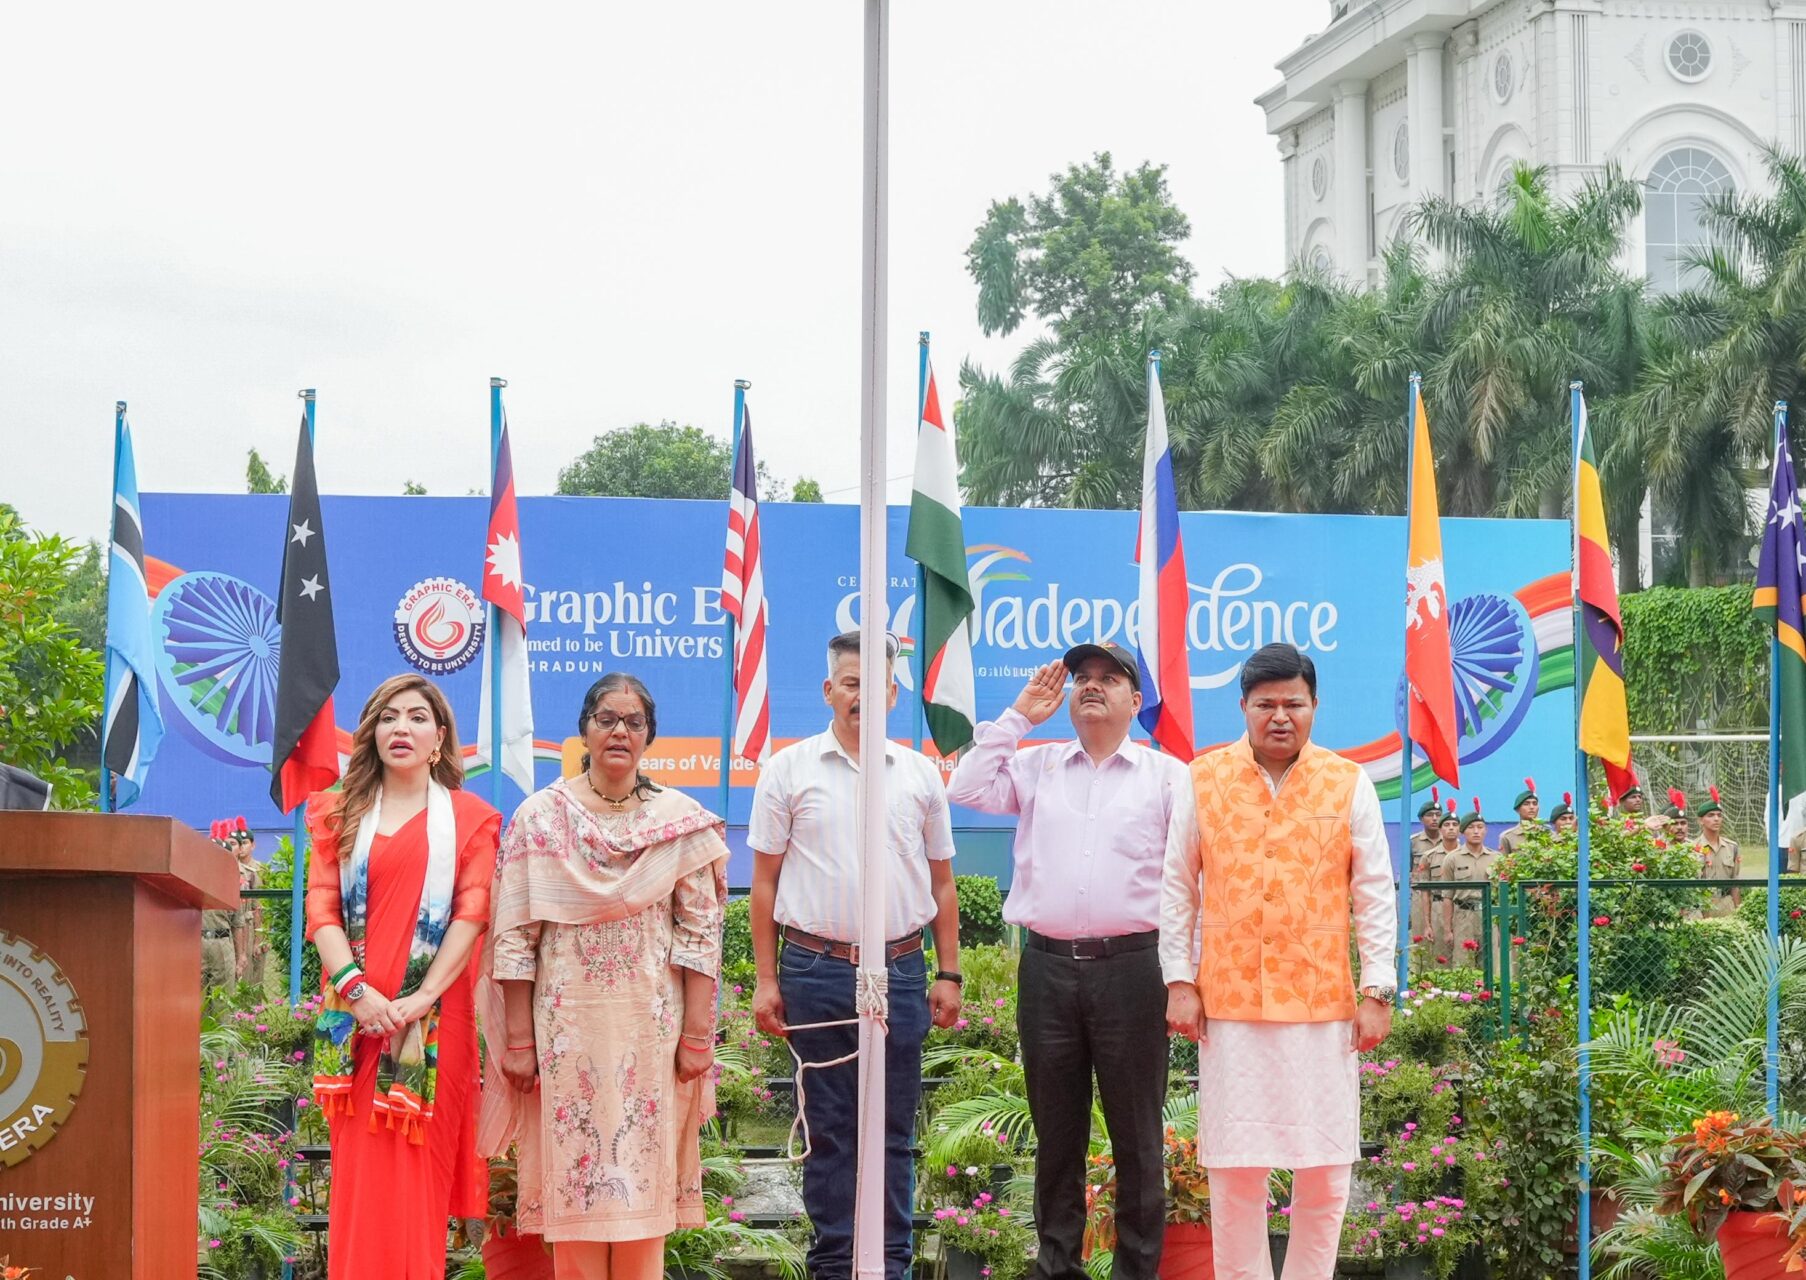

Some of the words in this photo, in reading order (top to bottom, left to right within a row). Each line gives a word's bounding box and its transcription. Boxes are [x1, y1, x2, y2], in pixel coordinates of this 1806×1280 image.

[404, 583, 453, 611] GRAPHIC
[455, 588, 475, 610] ERA
[397, 625, 418, 661] DEEMED
[418, 657, 430, 669] TO
[431, 663, 443, 671] BE
[444, 624, 482, 670] UNIVERSITY
[528, 637, 560, 652] med
[566, 638, 580, 652] to
[584, 637, 604, 652] be
[609, 628, 723, 658] Univers
[528, 661, 603, 673] HRADUN
[639, 757, 676, 770] ears
[679, 754, 697, 770] of
[3, 954, 34, 978] INTO
[31, 977, 65, 1032] REALITY
[0, 1104, 55, 1151] ERA
[0, 1192, 95, 1215] niversity
[1, 1218, 16, 1230] th
[20, 1217, 69, 1230] Grade
[73, 1216, 92, 1230] A+
